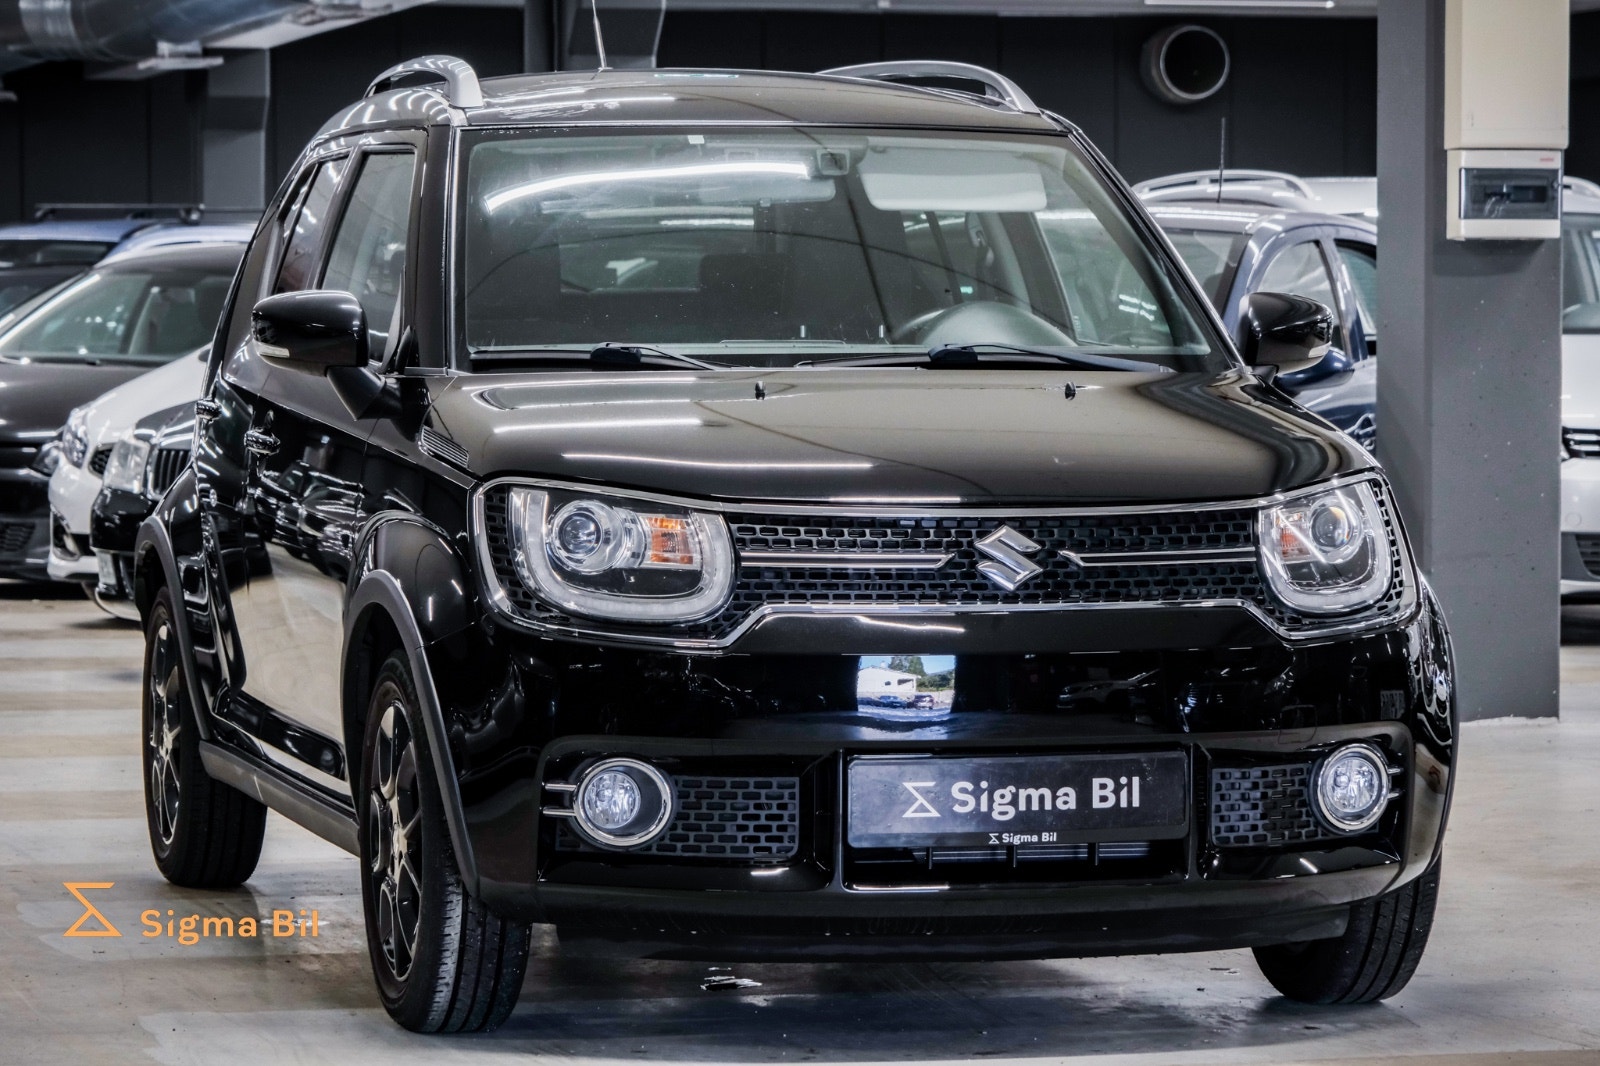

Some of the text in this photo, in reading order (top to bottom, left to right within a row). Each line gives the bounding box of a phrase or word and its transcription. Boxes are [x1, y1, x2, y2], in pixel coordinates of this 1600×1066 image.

[951, 776, 1140, 821] Sigma Bil
[1001, 831, 1057, 845] Sigma Bil
